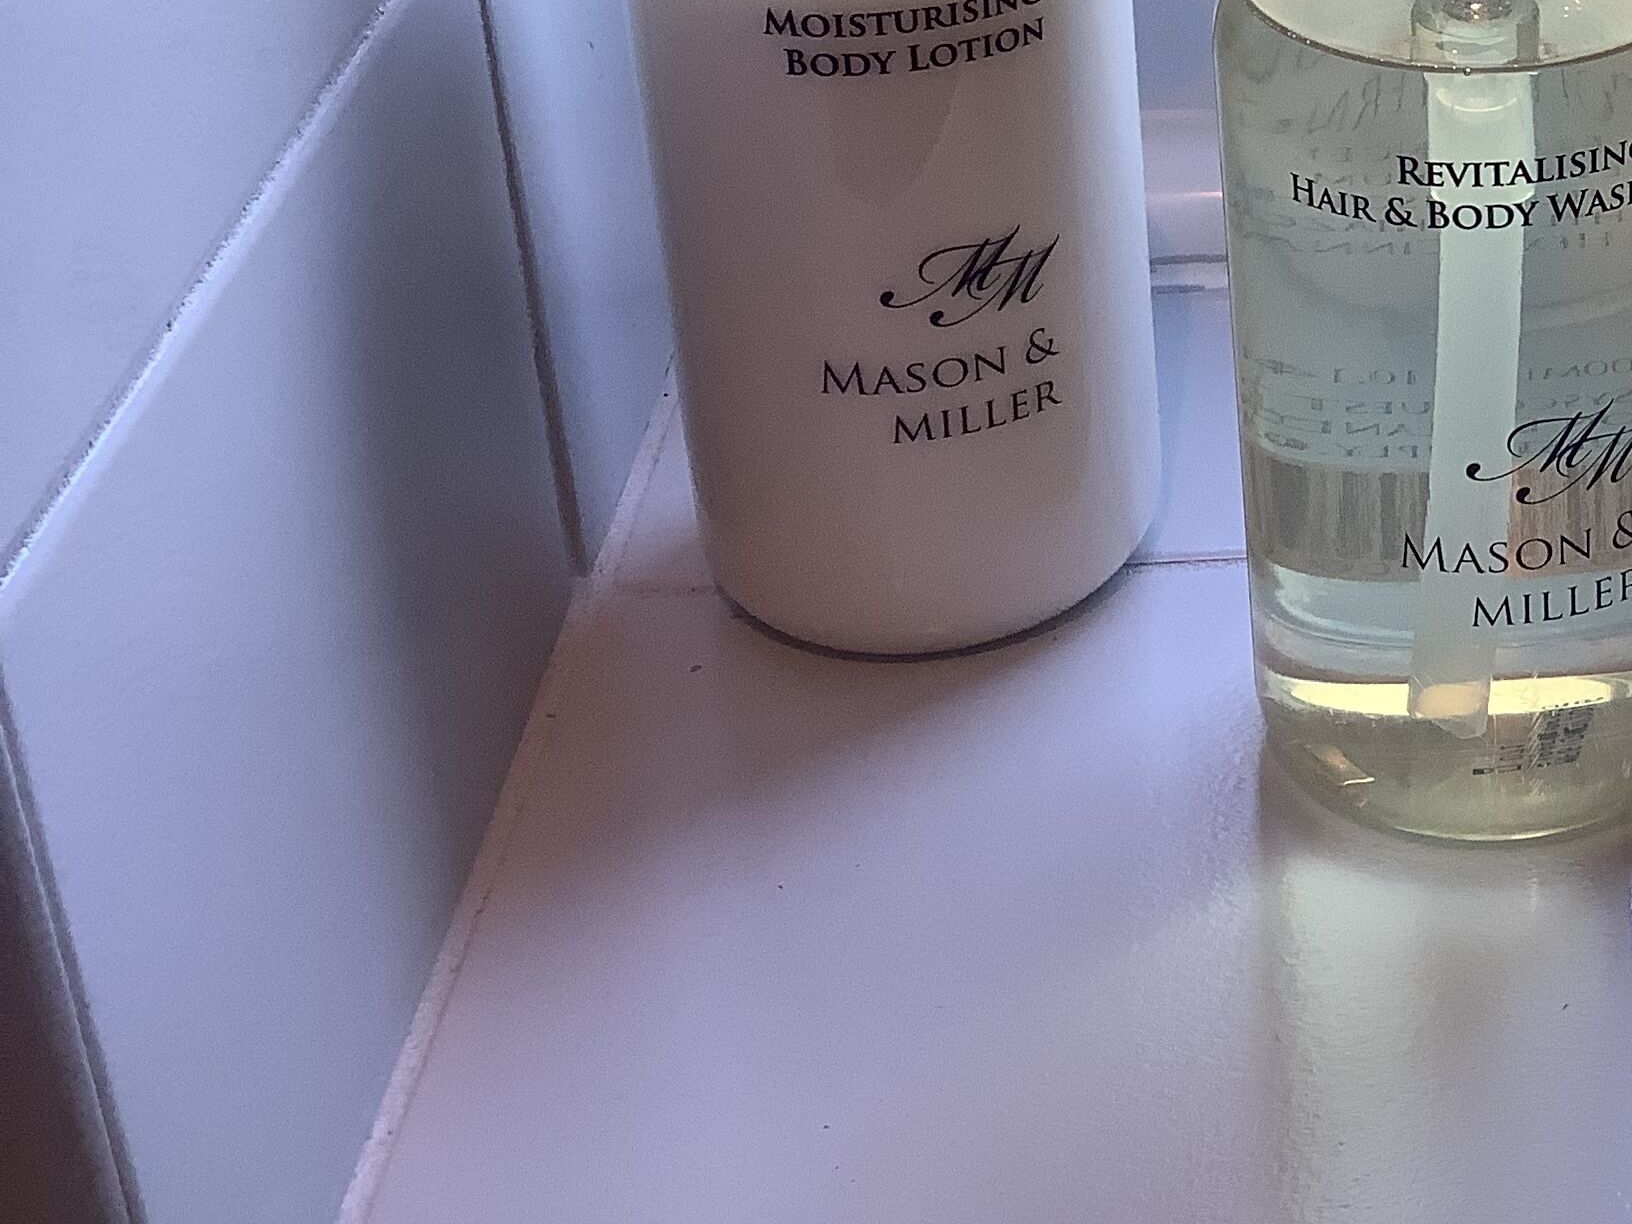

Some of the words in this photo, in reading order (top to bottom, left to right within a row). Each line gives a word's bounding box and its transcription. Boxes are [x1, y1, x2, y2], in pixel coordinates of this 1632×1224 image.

[784, 48, 896, 77] BODY
[908, 17, 1045, 72] LOTION
[1290, 172, 1376, 223] HAIR
[1384, 197, 1418, 228] &
[1427, 200, 1539, 230] BODY
[821, 346, 1007, 396] MASON
[1025, 327, 1059, 364] &
[893, 380, 1062, 444] MILLER
[1401, 527, 1592, 576] MASON
